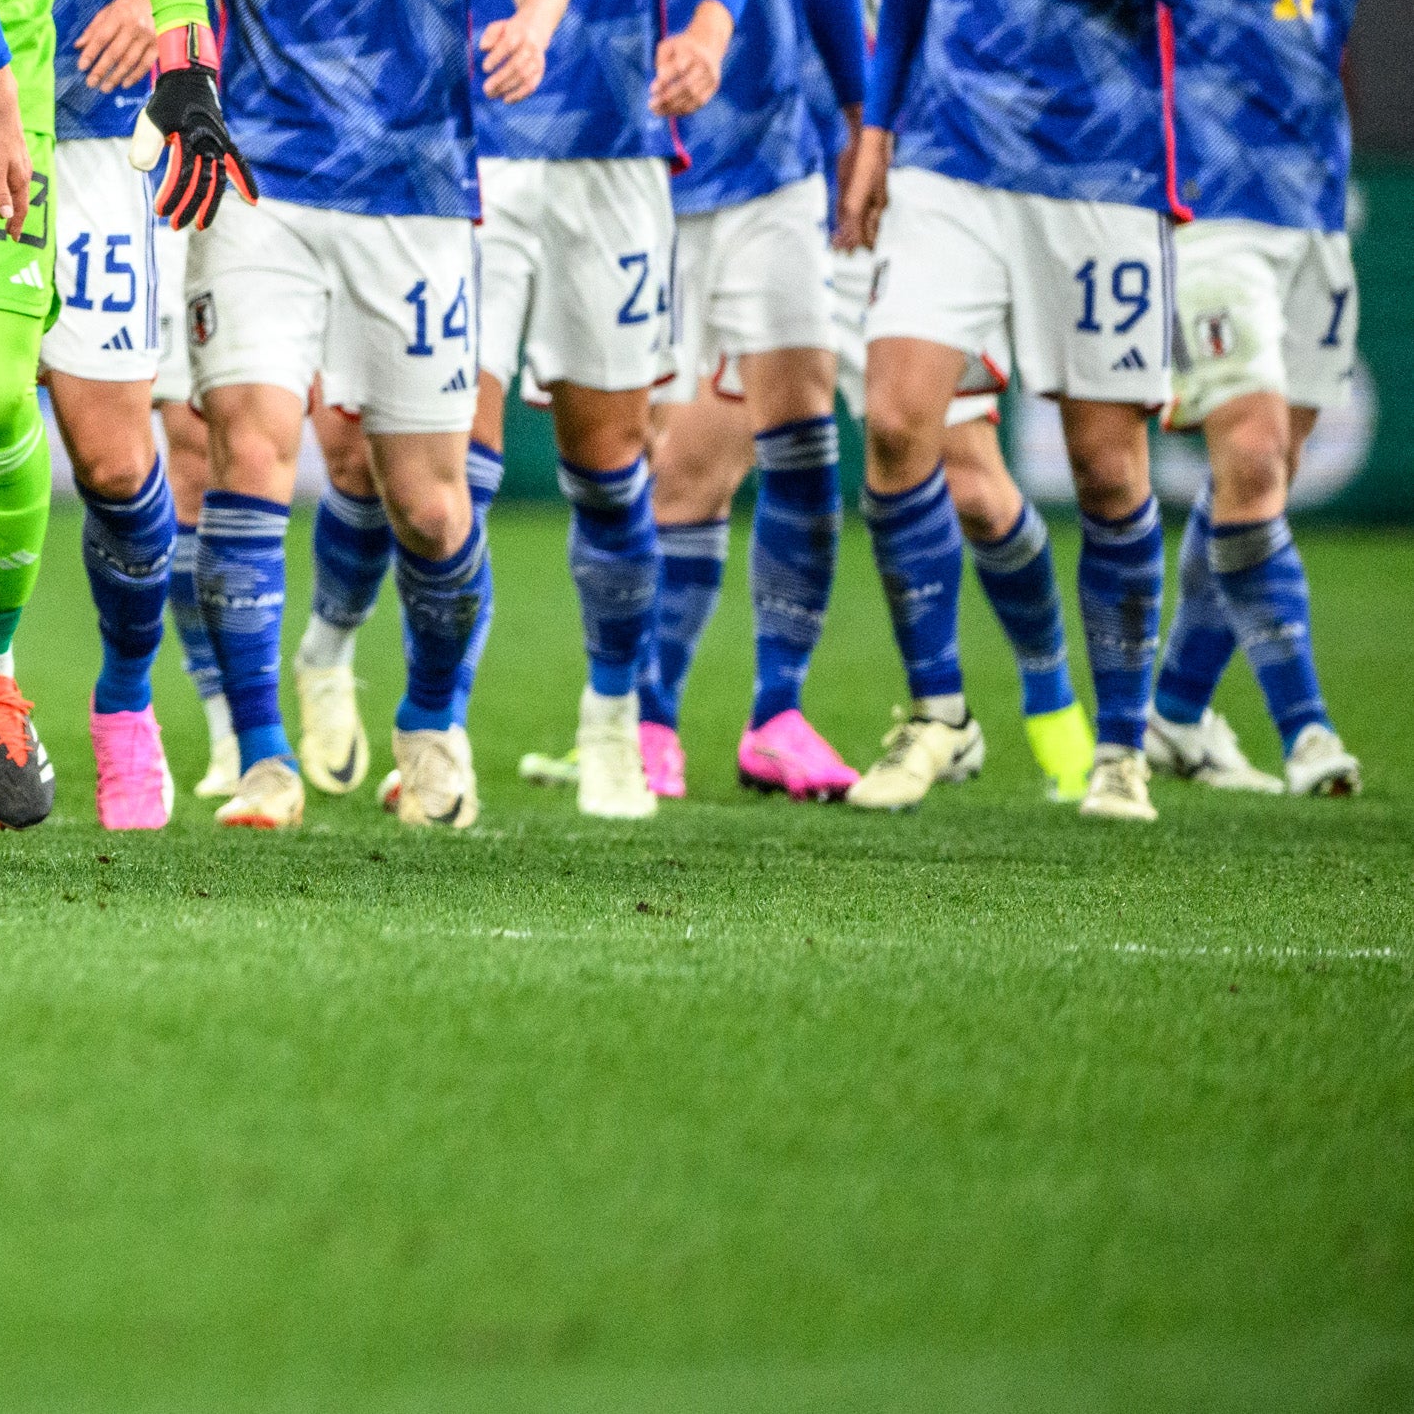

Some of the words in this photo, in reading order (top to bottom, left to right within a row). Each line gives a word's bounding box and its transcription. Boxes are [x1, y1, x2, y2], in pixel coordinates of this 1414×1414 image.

[64, 230, 139, 314] 15
[1075, 258, 1152, 335] 19
[404, 278, 469, 357] 14
